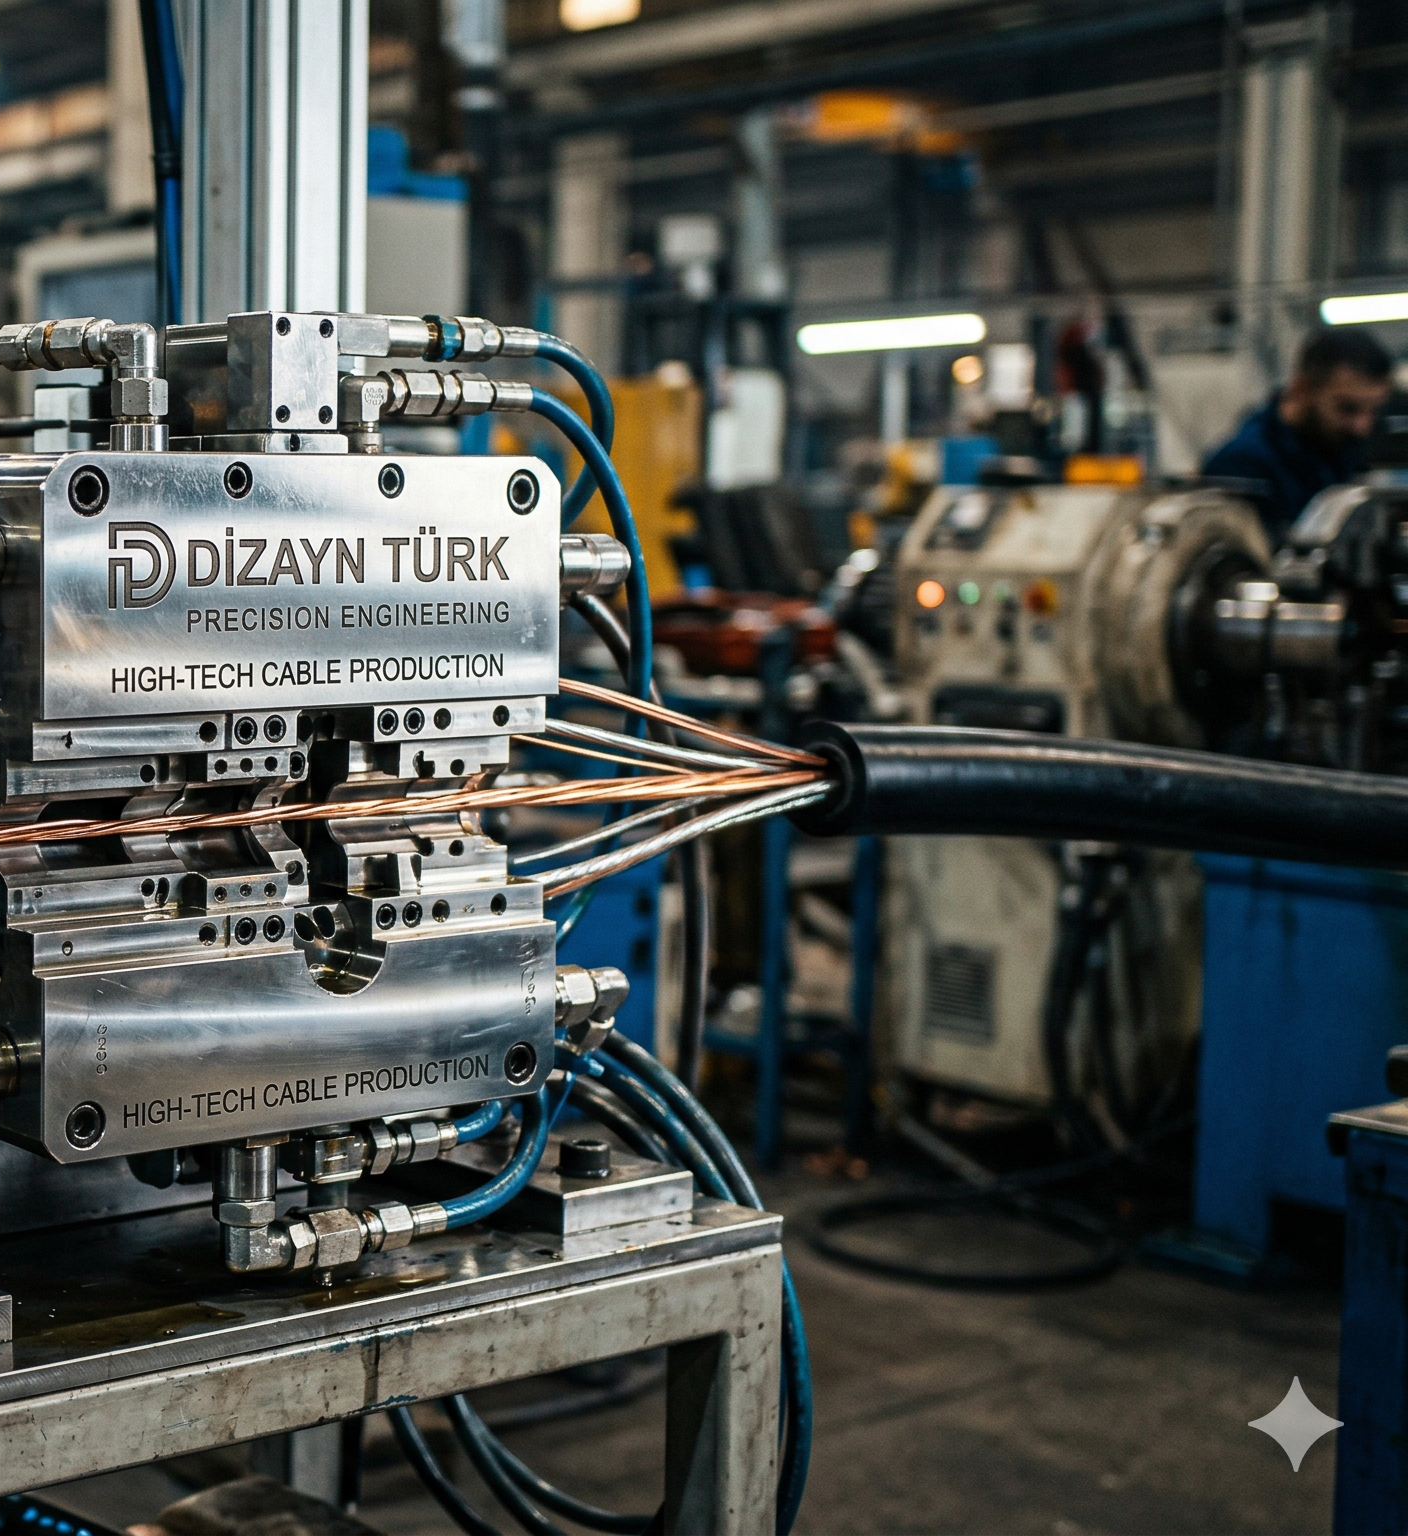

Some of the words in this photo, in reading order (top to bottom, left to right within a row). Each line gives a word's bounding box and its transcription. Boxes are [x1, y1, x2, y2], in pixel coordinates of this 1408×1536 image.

[382, 526, 511, 583] TÜRK
[186, 605, 330, 633] PRECISION
[341, 600, 511, 628] ENGINEERING
[111, 662, 254, 694] HIGH-TECH
[261, 659, 342, 687] CABLE
[349, 652, 504, 683] PRODUCTION
[122, 1086, 257, 1129] HIGH-TECH
[262, 1075, 339, 1108] CABLE
[344, 1054, 491, 1097] PRODUCTION
